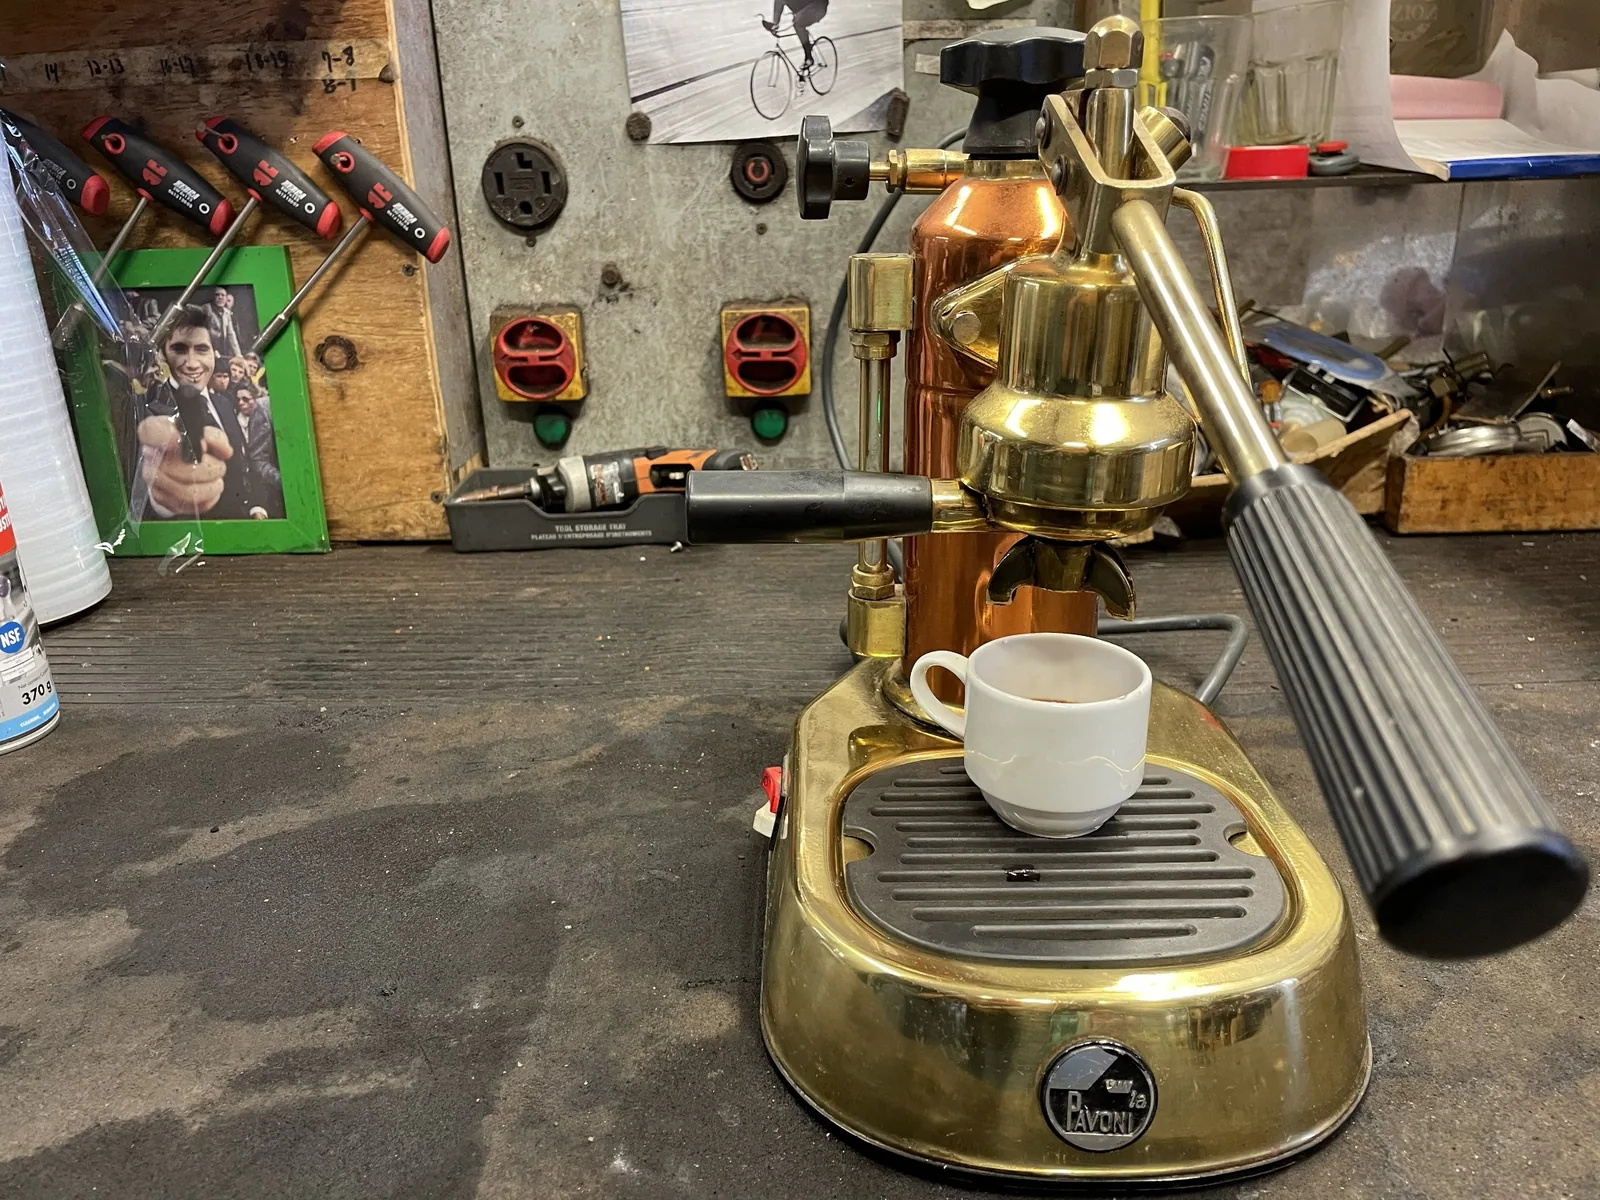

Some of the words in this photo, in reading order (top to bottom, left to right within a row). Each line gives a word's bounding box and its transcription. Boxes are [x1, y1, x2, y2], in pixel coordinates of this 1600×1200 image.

[45, 63, 59, 83] 14
[321, 45, 355, 73] 7-8
[0, 627, 20, 648] NSF
[22, 683, 45, 705] 370
[46, 680, 52, 693] g
[1066, 1091, 1134, 1134] PAVONI
